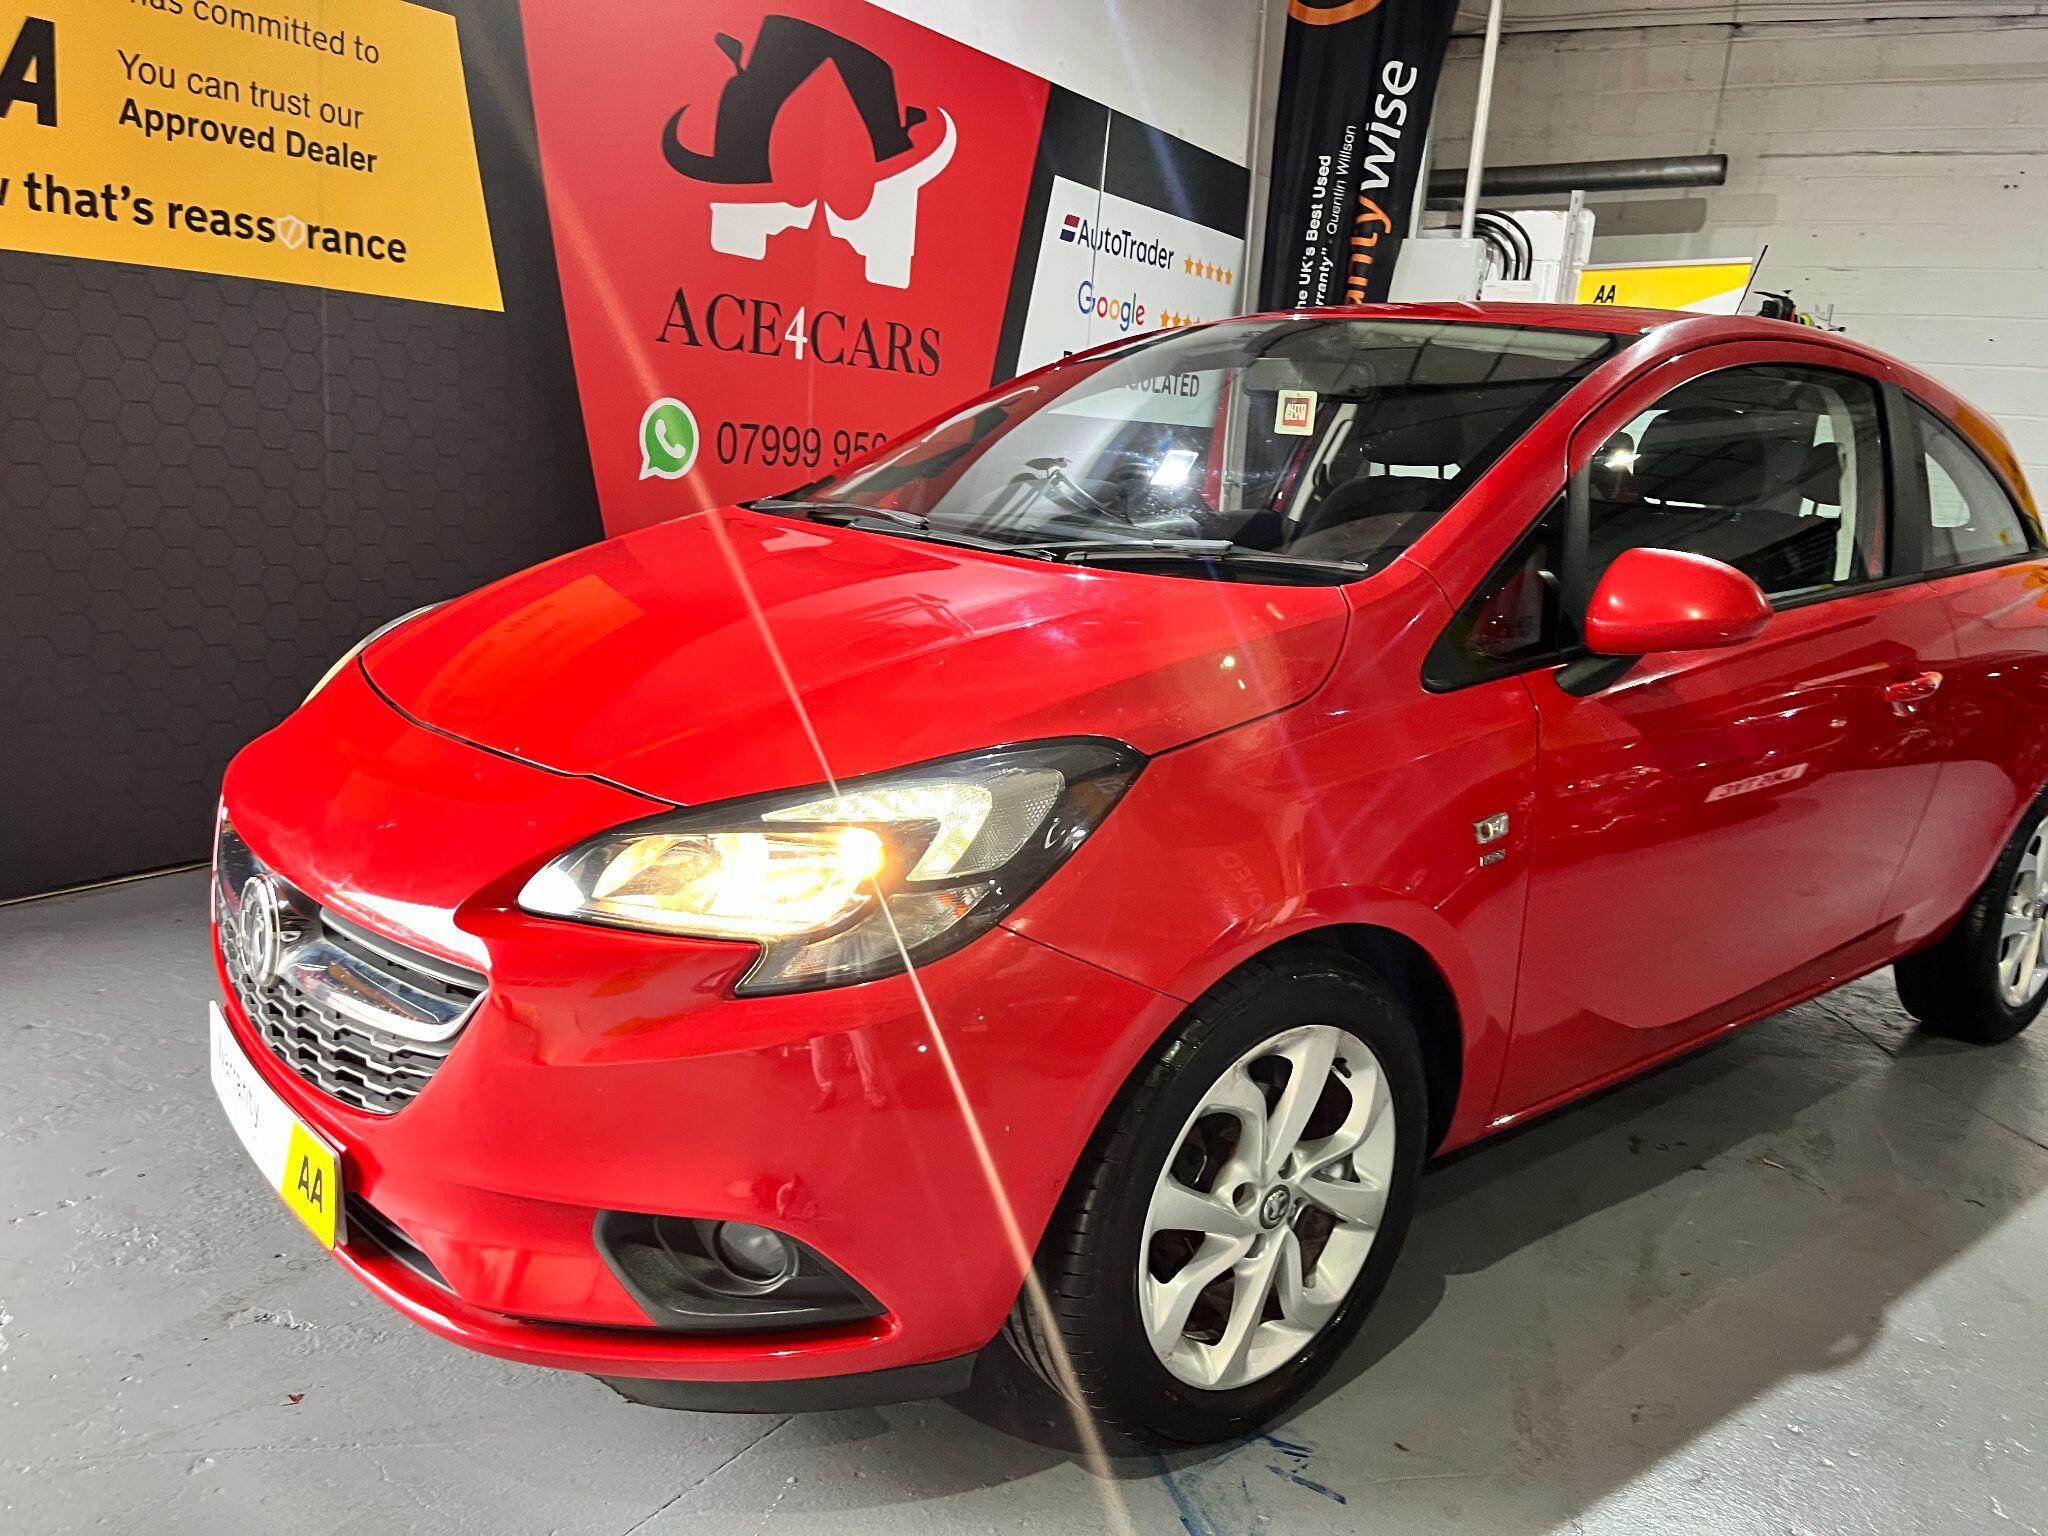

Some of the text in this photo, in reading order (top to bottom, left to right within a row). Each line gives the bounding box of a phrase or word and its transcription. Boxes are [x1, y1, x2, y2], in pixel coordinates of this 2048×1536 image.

[194, 0, 345, 56] committed
[355, 35, 380, 64] to
[0, 16, 57, 127] A
[117, 49, 365, 129] You can trust our
[118, 97, 378, 172] Approved Dealer
[1335, 125, 1357, 175] Willson
[23, 172, 154, 225] that’s
[1312, 155, 1332, 198] Used
[1077, 219, 1175, 270] AutoTrader
[1305, 203, 1323, 241] Best
[1077, 280, 1145, 331] Google
[1593, 284, 1617, 304] AA
[656, 287, 941, 376] ACE4CARS
[716, 421, 822, 468] 07999
[298, 1155, 323, 1214] AA
